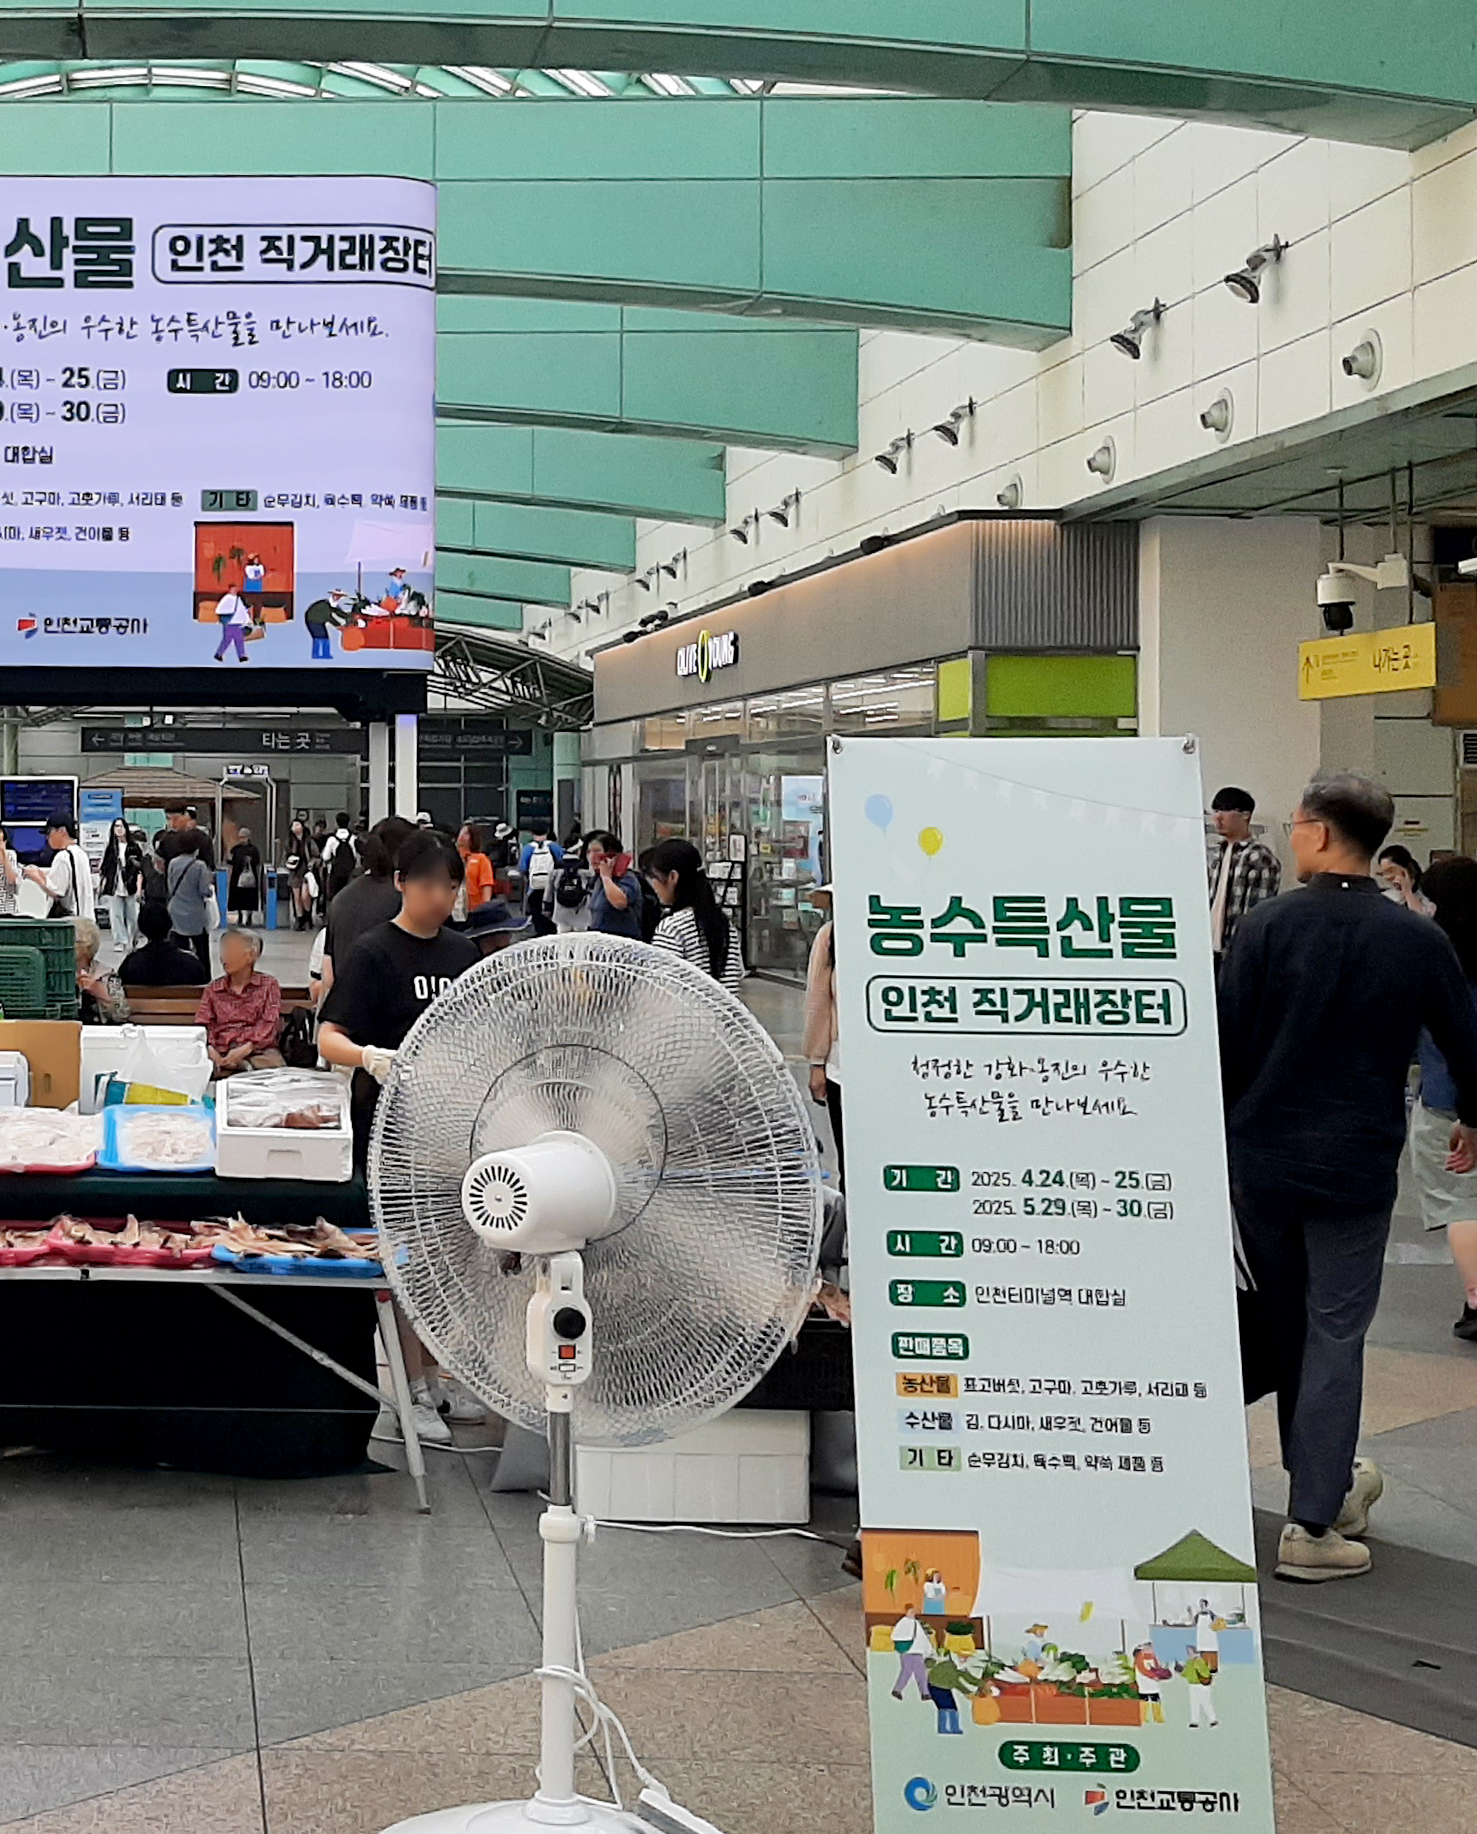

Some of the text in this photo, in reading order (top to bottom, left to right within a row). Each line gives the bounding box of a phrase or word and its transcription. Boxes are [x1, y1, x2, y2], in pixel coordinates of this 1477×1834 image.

[168, 234, 432, 280] 인천 직거래장터
[81, 313, 139, 341] 우수한
[149, 309, 261, 348] 농수특산물을
[270, 314, 390, 342] 만나보세요.
[248, 371, 300, 389] 09:00
[322, 371, 372, 389] 18:00
[4, 445, 54, 465] 대합실
[867, 894, 1178, 959] 농수특산물
[881, 985, 1173, 1026] 인천 직거래장터
[911, 1055, 974, 1080] 청정한
[1097, 1059, 1152, 1083] 우수한
[924, 1091, 1023, 1123] 농수특산물을
[971, 1171, 1017, 1187] 2025.
[973, 1199, 1017, 1215] 2025.
[971, 1238, 1017, 1254] 09:00
[1035, 1239, 1080, 1255] 18:00
[974, 1286, 1072, 1306] 인천터미널역
[1078, 1288, 1127, 1307] 대합실
[944, 1784, 1056, 1809] 인천광역시
[1115, 1788, 1240, 1814] 인천교통공사
